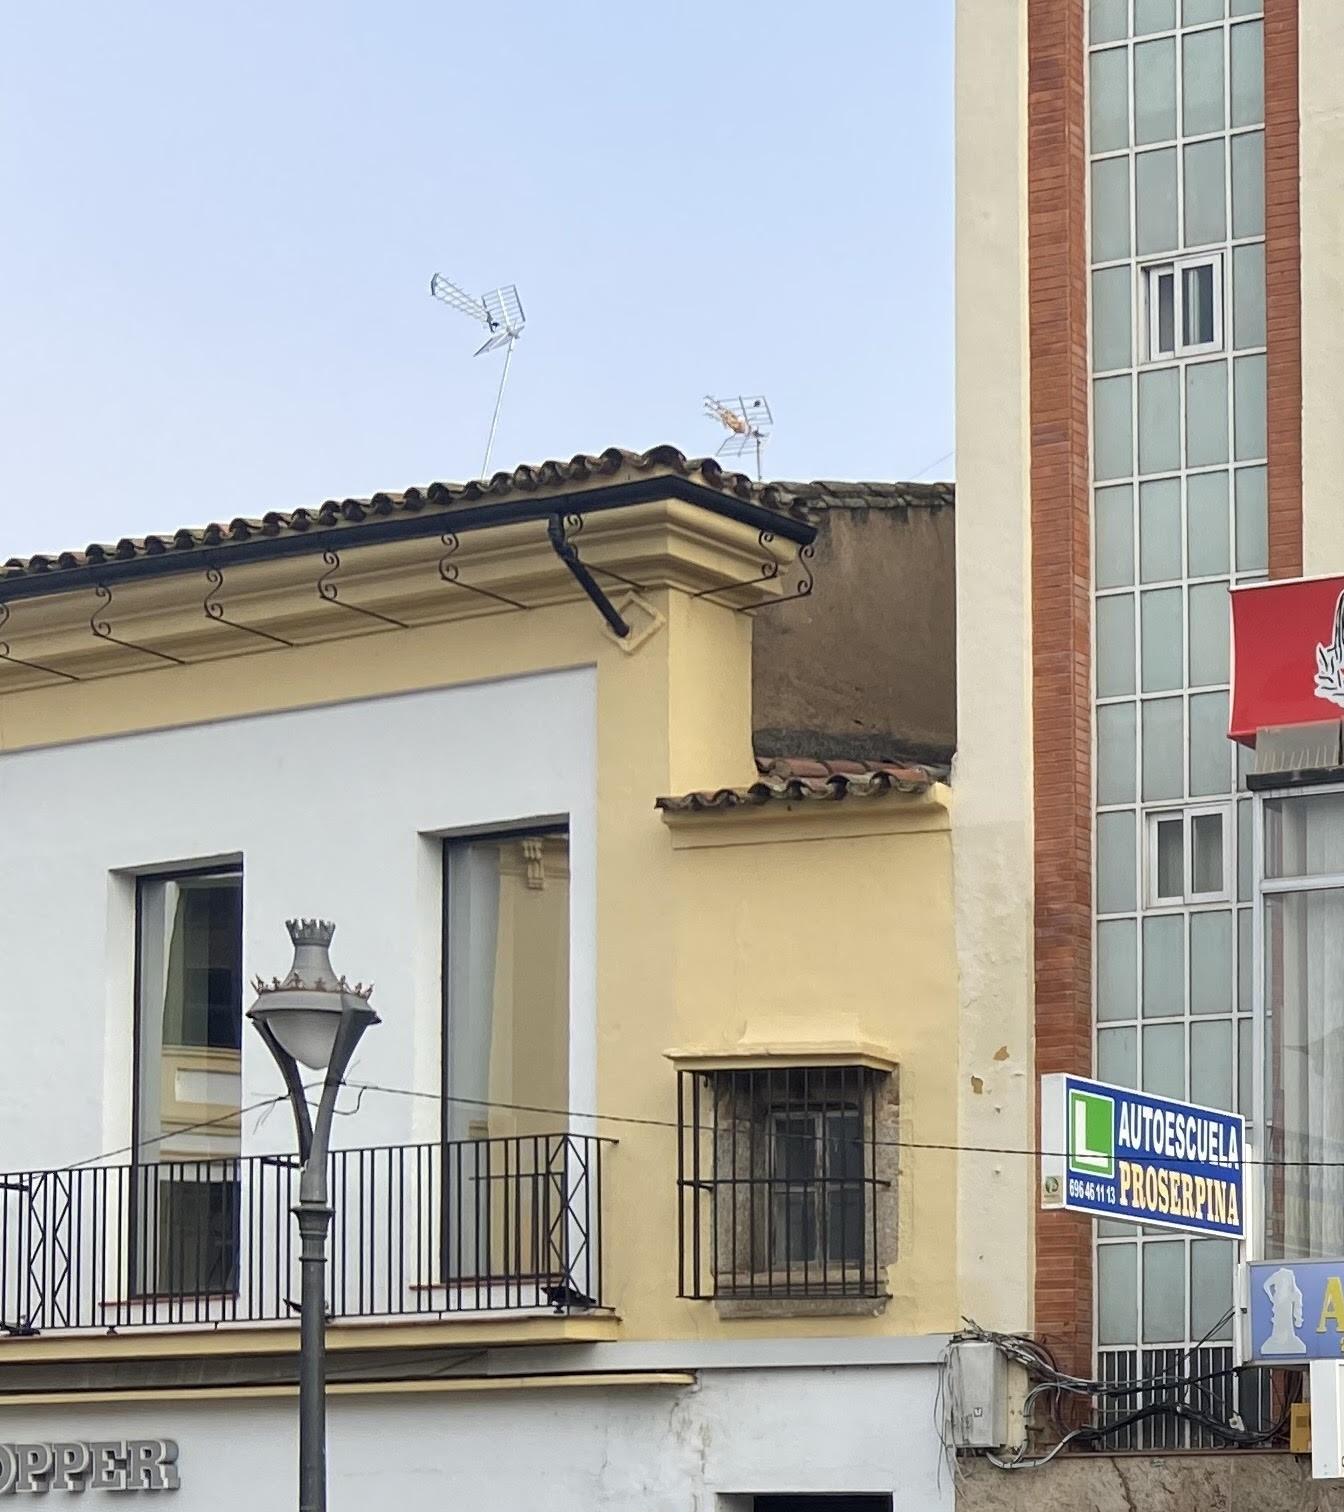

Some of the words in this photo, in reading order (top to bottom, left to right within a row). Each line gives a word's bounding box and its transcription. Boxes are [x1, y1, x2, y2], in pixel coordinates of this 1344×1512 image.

[1075, 1100, 1108, 1168] L
[1118, 1101, 1239, 1170] AUTOESCUELA
[1070, 1178, 1084, 1199] 696
[1085, 1181, 1095, 1201] 46
[1096, 1183, 1105, 1202] 11
[1107, 1185, 1116, 1205] 13
[1118, 1161, 1240, 1226] PROSERPINA
